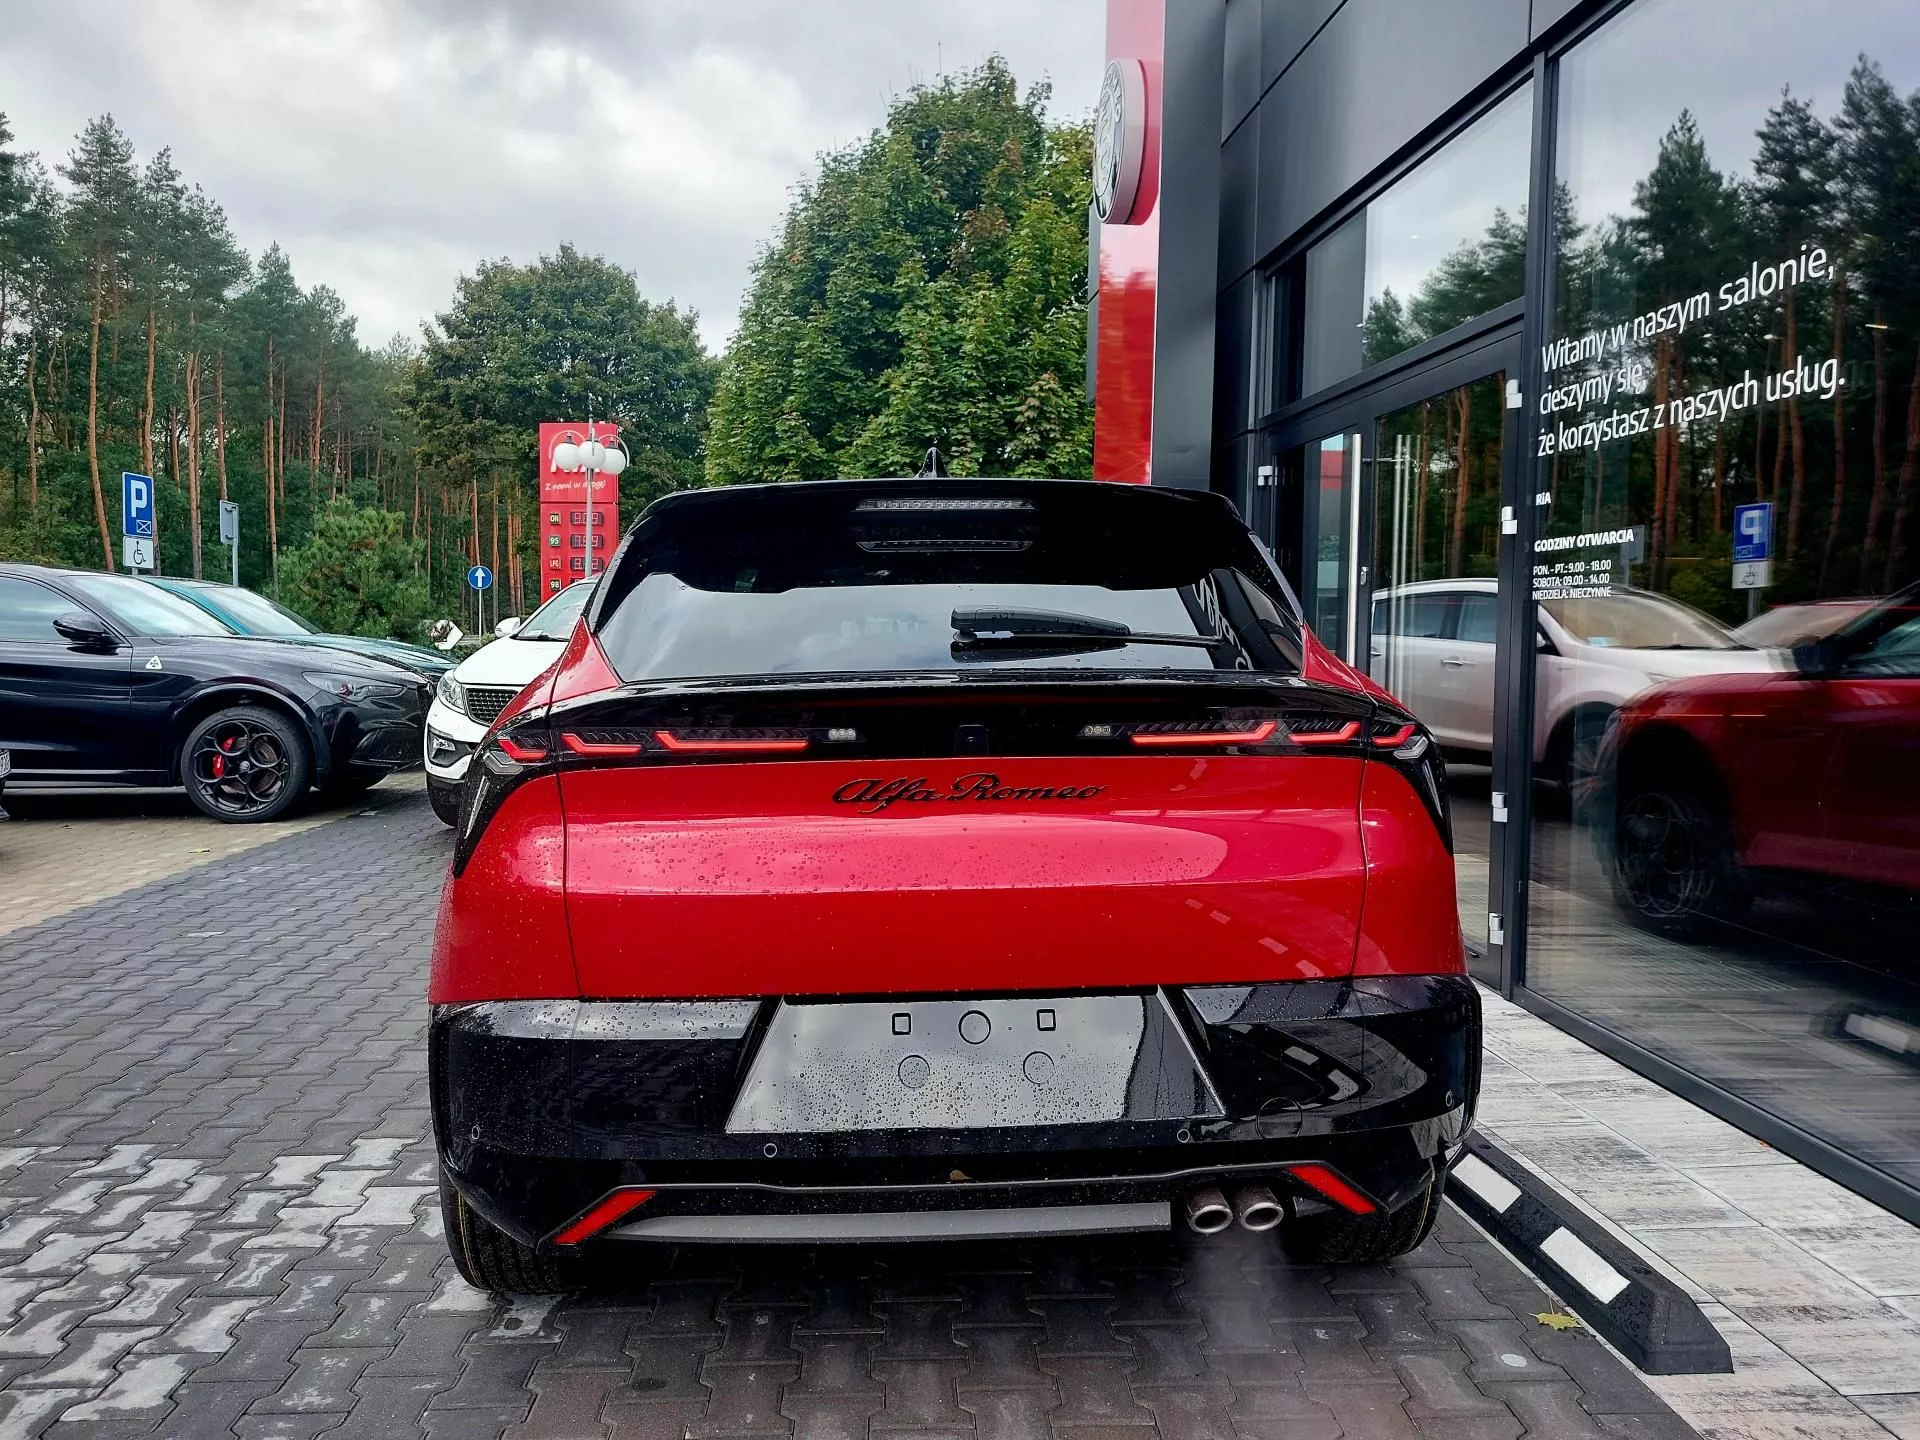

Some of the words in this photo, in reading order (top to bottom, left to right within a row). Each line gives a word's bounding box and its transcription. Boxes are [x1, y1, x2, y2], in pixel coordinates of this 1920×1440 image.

[1541, 329, 1608, 373] Witamy
[1611, 323, 1630, 348] w
[1633, 290, 1710, 342] naszym
[1718, 244, 1835, 312] salonie,
[1539, 372, 1614, 415] cieszymy
[1616, 358, 1647, 395] się,
[1537, 428, 1555, 457] że
[1558, 406, 1650, 452] korzystasz
[1653, 405, 1666, 429] z
[1670, 369, 1758, 423] naszych
[1765, 354, 1845, 402] usług.
[582, 479, 607, 490] dogę!
[130, 479, 148, 518] P
[549, 514, 559, 523] ON
[550, 537, 559, 545] 95
[1533, 535, 1577, 552] GODZINY
[1576, 528, 1635, 548] OTWARCIA
[1532, 565, 1550, 576] PON.
[1568, 561, 1585, 573] 9.00
[1590, 559, 1612, 571] 18.00
[550, 580, 559, 589] 98
[1532, 576, 1563, 588] SOBOTA:
[1562, 574, 1584, 586] 09.00
[1588, 572, 1610, 584] 14.00
[1532, 588, 1569, 601] NIEDZIELA:
[1568, 586, 1612, 599] NIECZYNNE
[831, 776, 944, 814] Alfa
[944, 772, 1107, 801] Romeo
